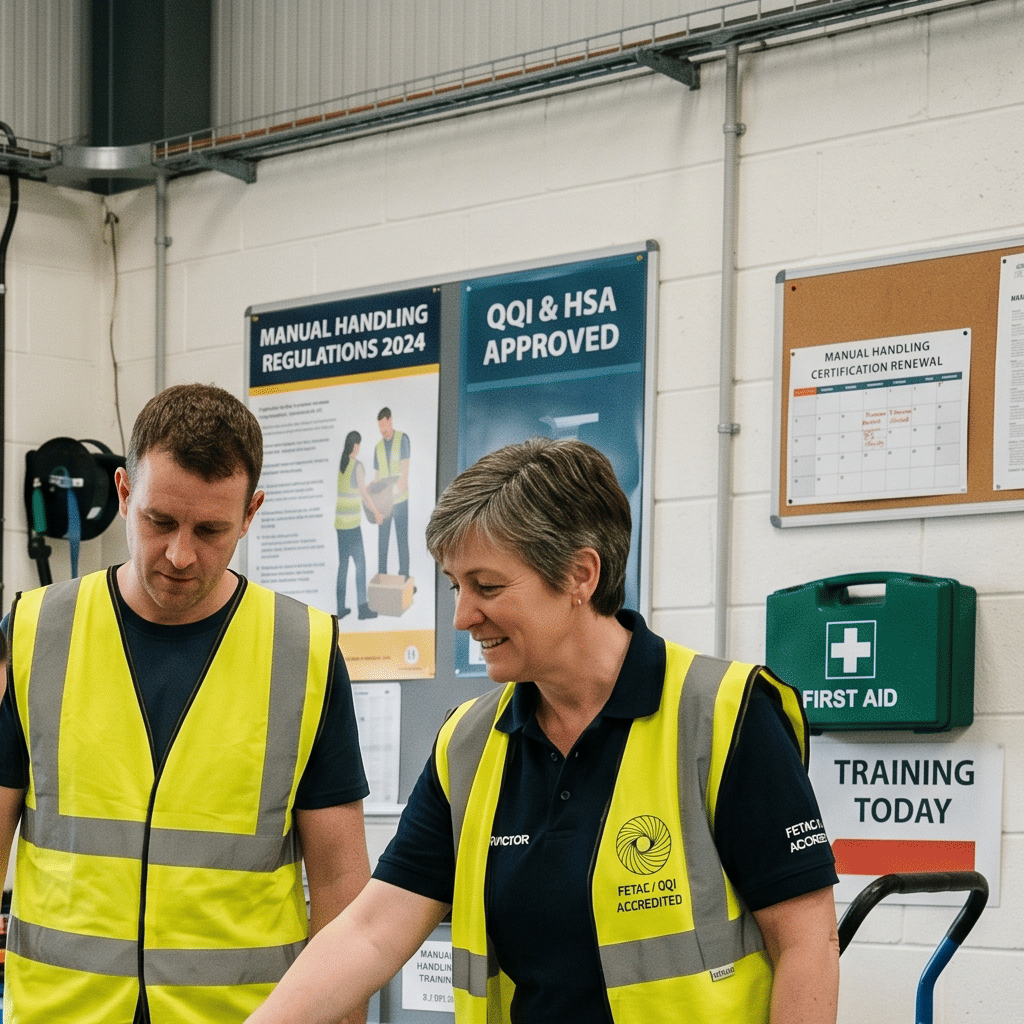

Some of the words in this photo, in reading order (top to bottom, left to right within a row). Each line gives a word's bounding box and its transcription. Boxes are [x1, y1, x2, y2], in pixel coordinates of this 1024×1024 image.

[487, 298, 533, 331] QQI
[538, 295, 558, 322] &
[564, 286, 617, 318] HSA
[260, 319, 331, 347] MANUAL
[335, 304, 428, 336] HANDLING
[262, 338, 378, 373] REGULATIONS
[381, 332, 426, 356] 2024
[483, 323, 620, 366] APPROVED
[824, 348, 869, 362] MANUAL
[872, 341, 930, 356] HANDLING
[811, 362, 888, 379] CERTIFICATION
[891, 356, 943, 371] RENEWAL
[803, 689, 858, 708] FIRST
[862, 688, 898, 707] AID
[834, 759, 975, 786] TRAINING
[854, 798, 953, 824] TODAY
[618, 882, 650, 896] FETAC
[617, 894, 683, 913] ACCREDITED
[416, 962, 452, 971] HANDLIN
[419, 974, 452, 984] TRAININ
